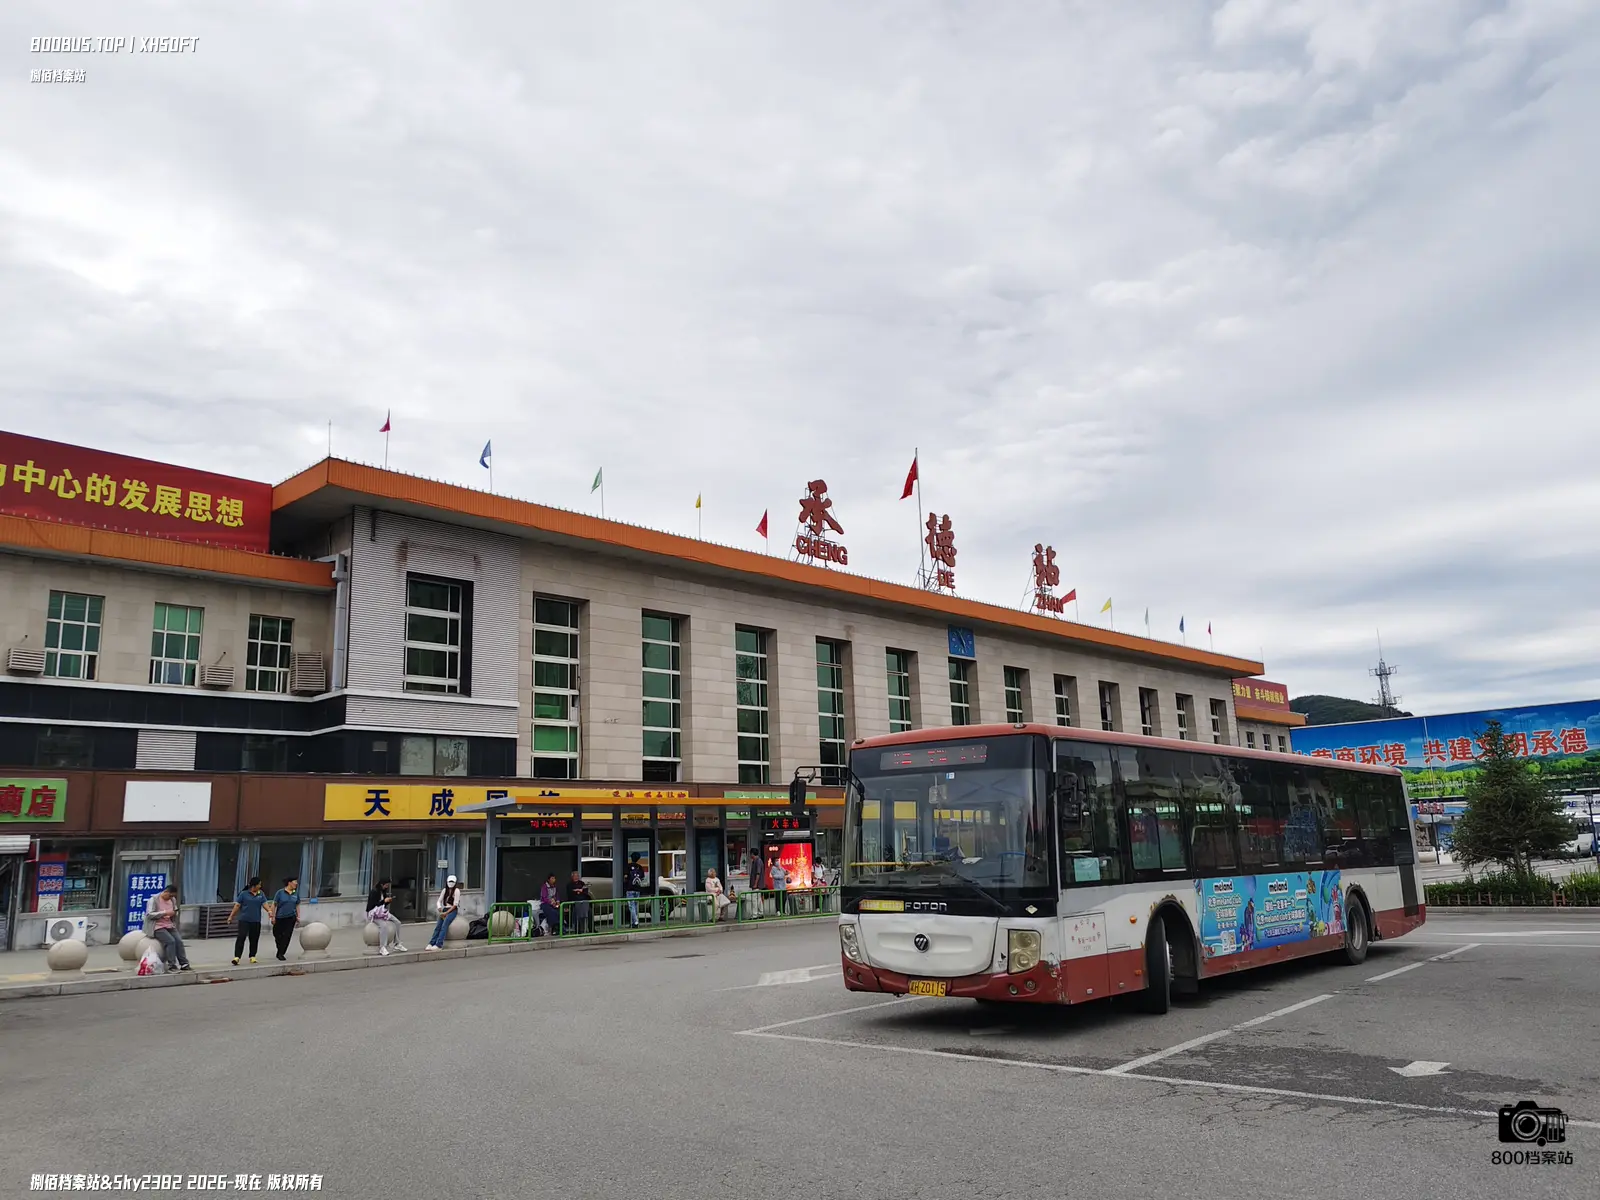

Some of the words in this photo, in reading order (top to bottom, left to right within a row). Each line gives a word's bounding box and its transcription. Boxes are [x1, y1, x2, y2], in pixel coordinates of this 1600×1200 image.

[0, 459, 245, 527] 中心的发展思想
[925, 512, 957, 567] 德
[1033, 543, 1060, 587] 站
[796, 534, 848, 566] CHENG
[937, 568, 956, 589] DE
[1034, 593, 1064, 614] ZHAN
[0, 784, 57, 817] 商店
[771, 817, 800, 829] 火车站
[1214, 880, 1233, 892] meland
[1268, 879, 1288, 892] meland
[905, 901, 947, 911] FOTON
